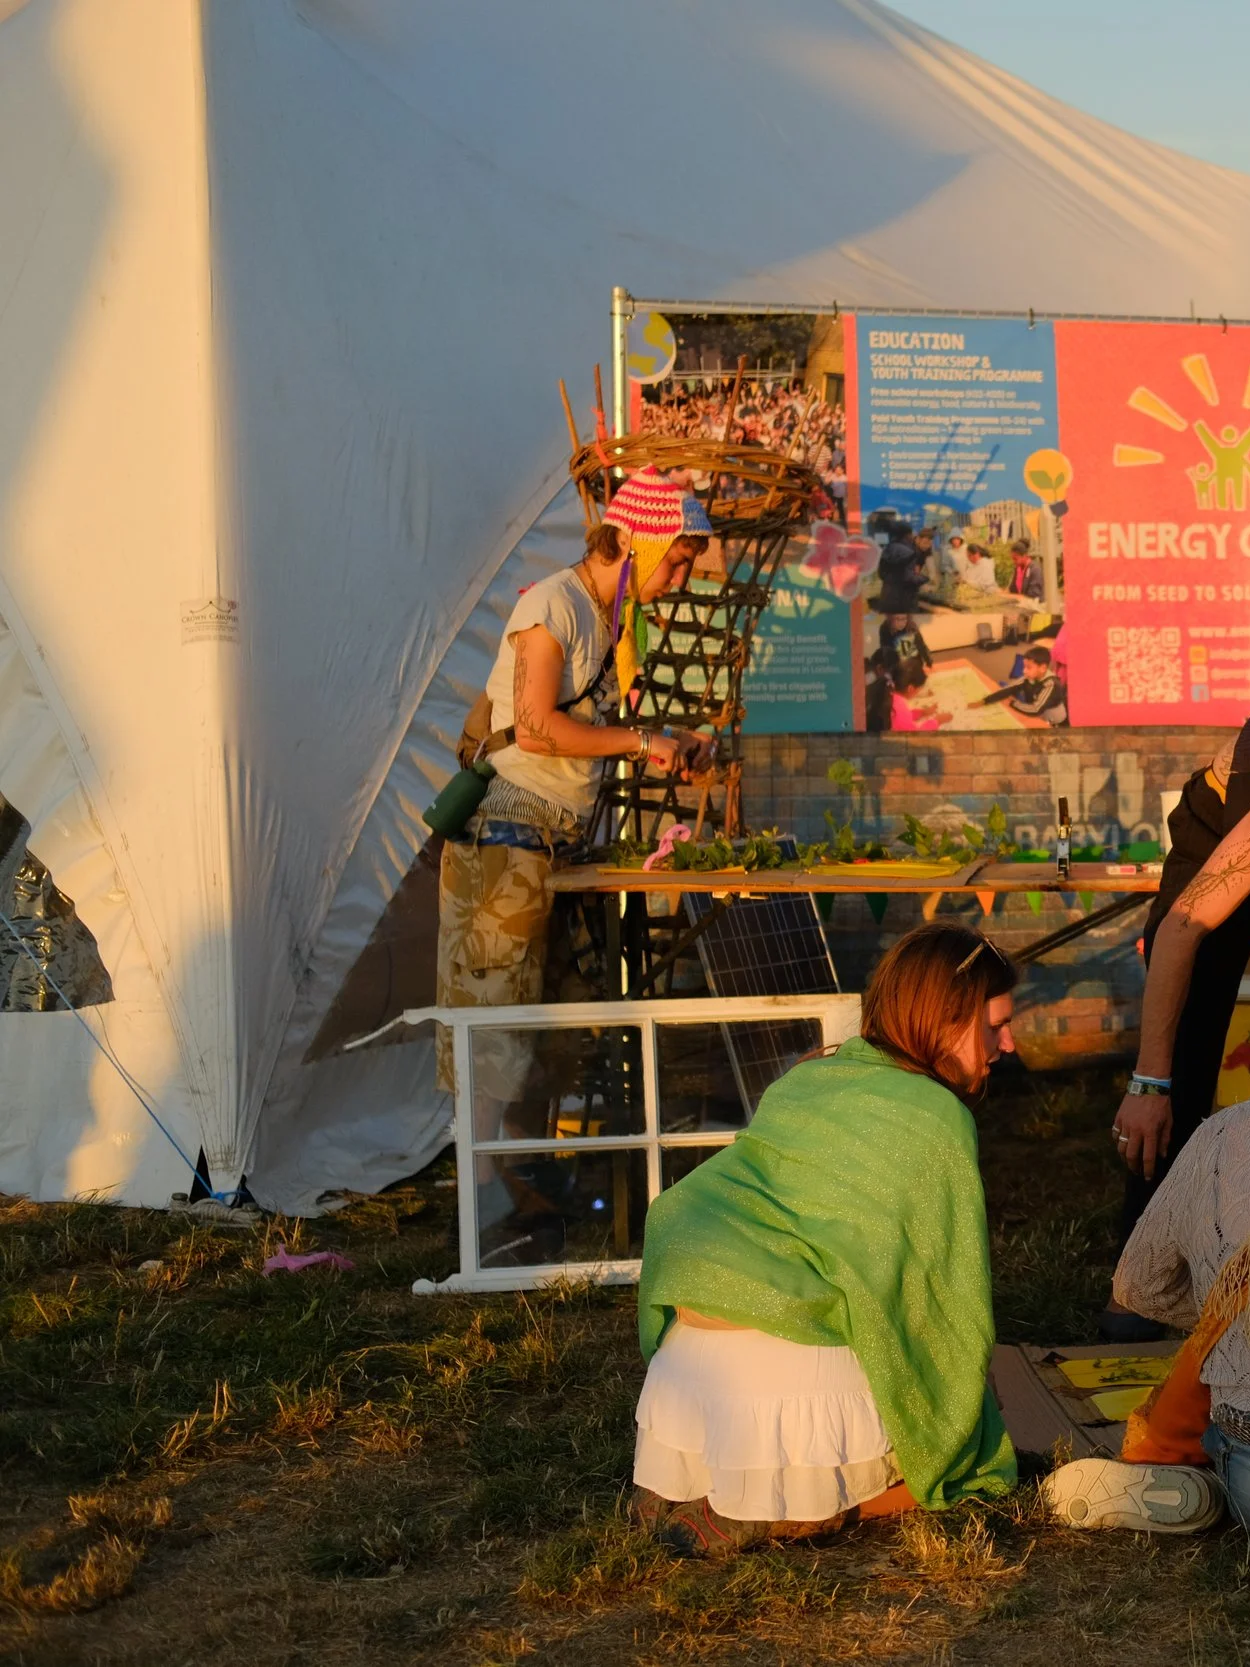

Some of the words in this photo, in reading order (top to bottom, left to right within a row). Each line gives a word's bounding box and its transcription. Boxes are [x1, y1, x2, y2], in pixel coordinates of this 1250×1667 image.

[869, 330, 965, 350] EDUCATION
[870, 354, 913, 367] SCHOOL
[915, 355, 980, 368] WORKSHOP
[982, 356, 991, 369] &
[871, 367, 909, 380] YOUTH
[911, 368, 972, 382] TRAINING
[972, 369, 1043, 384] PROGRAMME
[1088, 522, 1231, 560] ENERGY
[1092, 585, 1142, 601] FROM
[1146, 585, 1189, 601] SEED
[1195, 585, 1216, 602] TO
